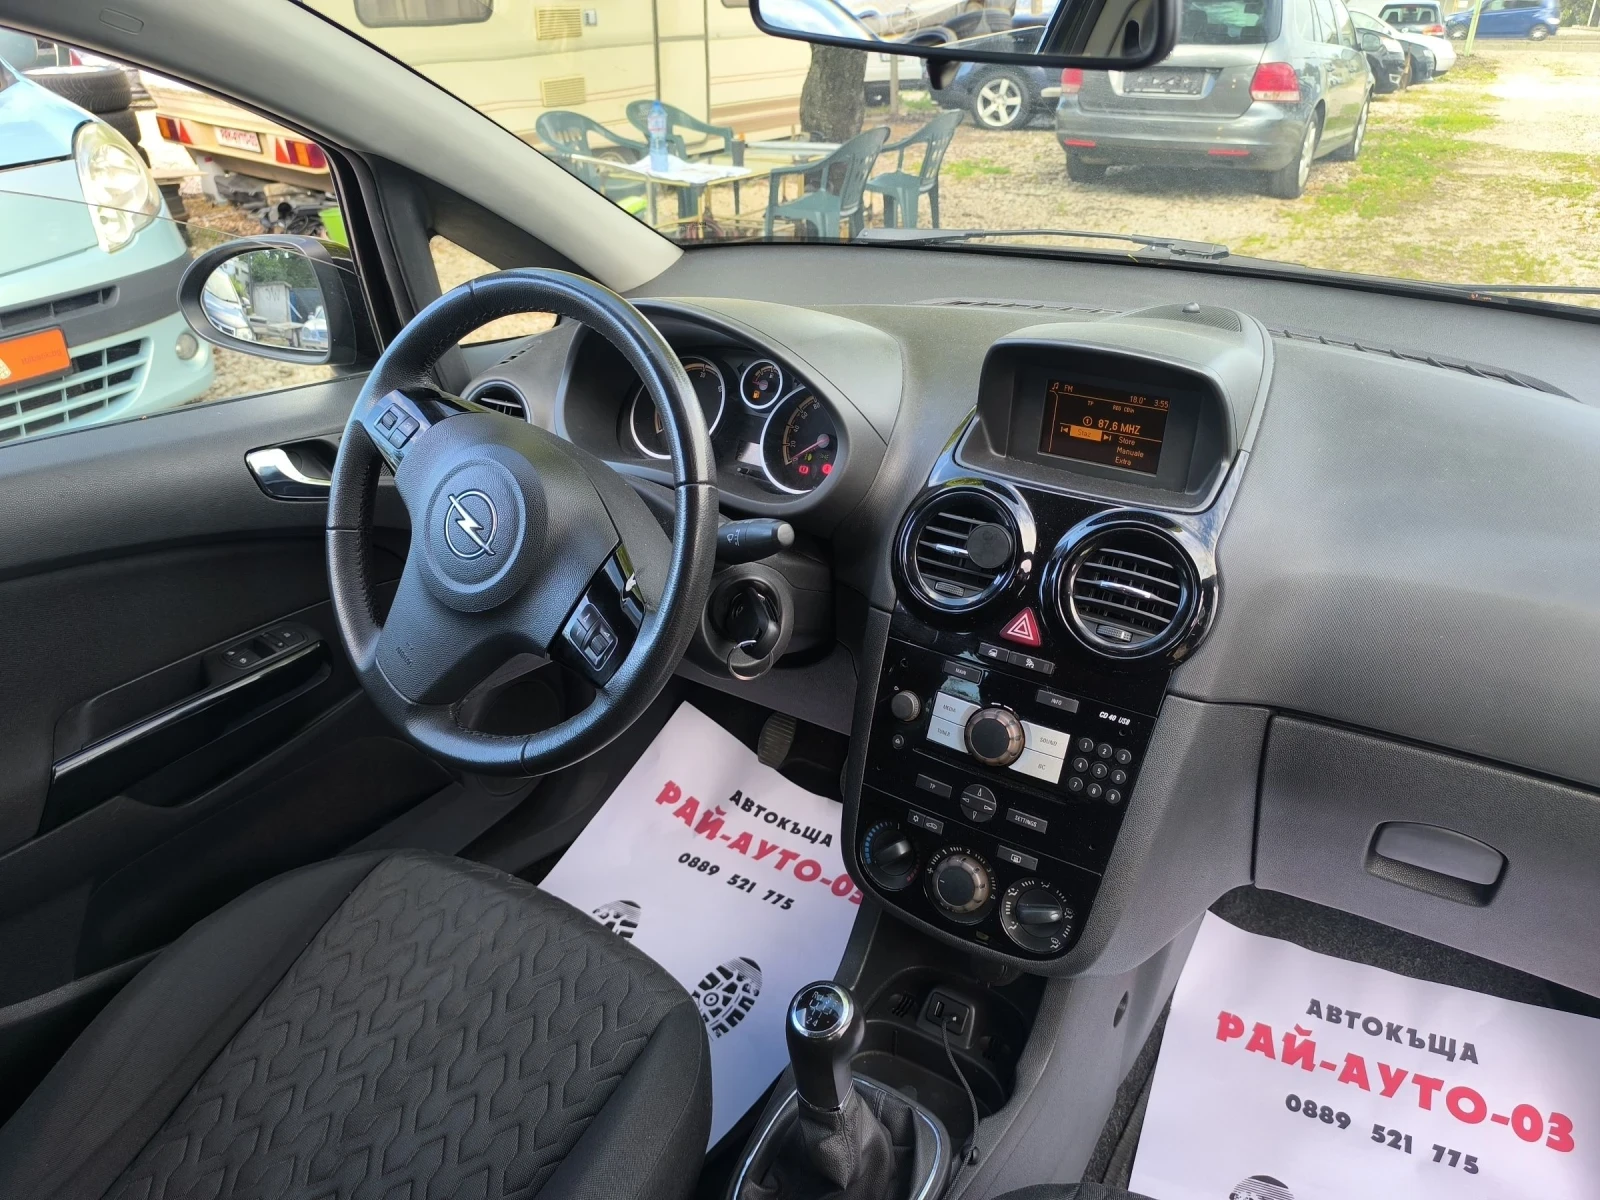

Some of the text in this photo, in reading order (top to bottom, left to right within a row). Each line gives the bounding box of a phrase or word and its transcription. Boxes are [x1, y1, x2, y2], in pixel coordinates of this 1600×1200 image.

[1064, 384, 1074, 392] FM
[1077, 428, 1091, 437] Staz
[1120, 423, 1141, 435] MHZ
[1118, 436, 1136, 446] Store
[1116, 446, 1144, 458] Manuale
[1114, 456, 1132, 466] Extra
[1099, 711, 1109, 719] CD
[1118, 716, 1131, 726] USB
[1039, 737, 1058, 747] SOUND
[1121, 753, 1126, 761] 3
[1096, 767, 1102, 775] 5
[1091, 787, 1097, 795] 8
[729, 789, 833, 847] АВТОКЪЩА
[1014, 814, 1038, 828] SETTINGS
[678, 852, 795, 910] 0889 521 775
[1306, 999, 1479, 1065] АВТОКЪЩА
[1216, 1011, 1576, 1154] РАЙ-АУТО-03
[1285, 1094, 1479, 1175] 0889 521 775
